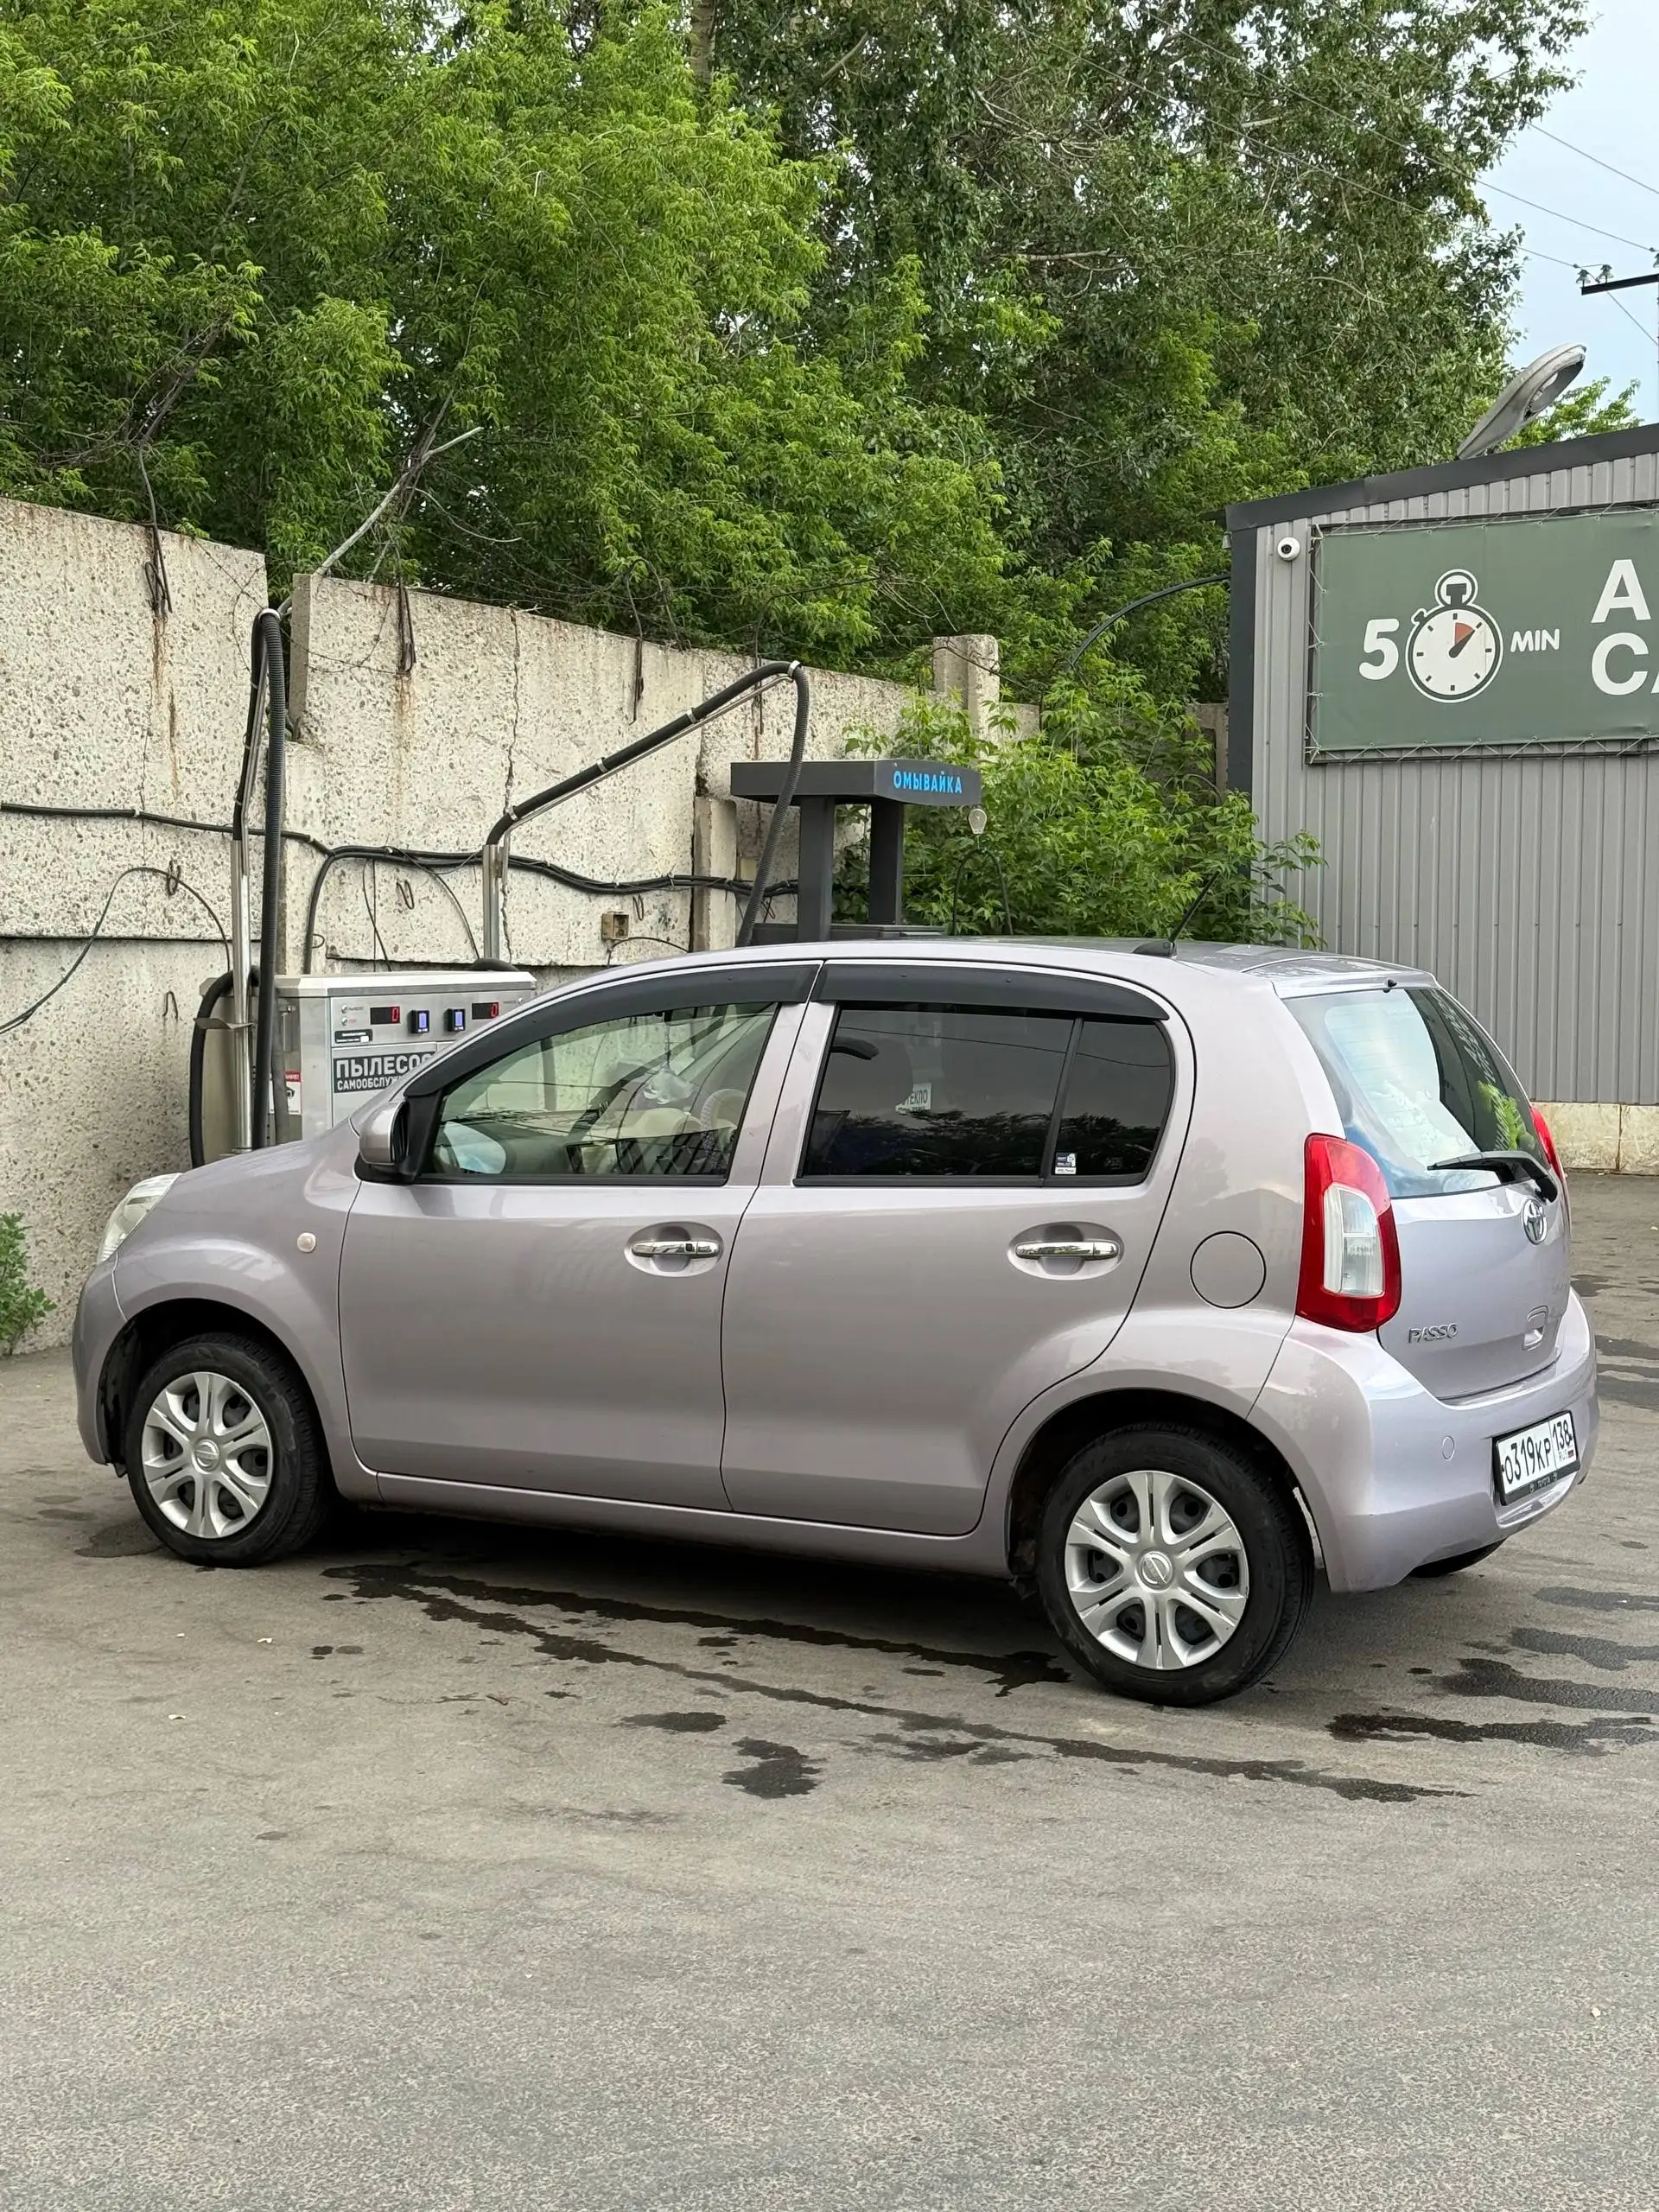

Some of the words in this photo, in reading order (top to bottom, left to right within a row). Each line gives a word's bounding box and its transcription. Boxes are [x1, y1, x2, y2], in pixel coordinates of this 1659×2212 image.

[1591, 559, 1651, 623] A
[1358, 618, 1400, 681] 5
[1510, 629, 1560, 652] MIN
[1591, 632, 1659, 696] C
[893, 770, 963, 794] ОМЫВАЙКА
[391, 1007, 399, 1024] 0
[1408, 1322, 1458, 1344] PASSO
[1552, 1419, 1572, 1451] 138
